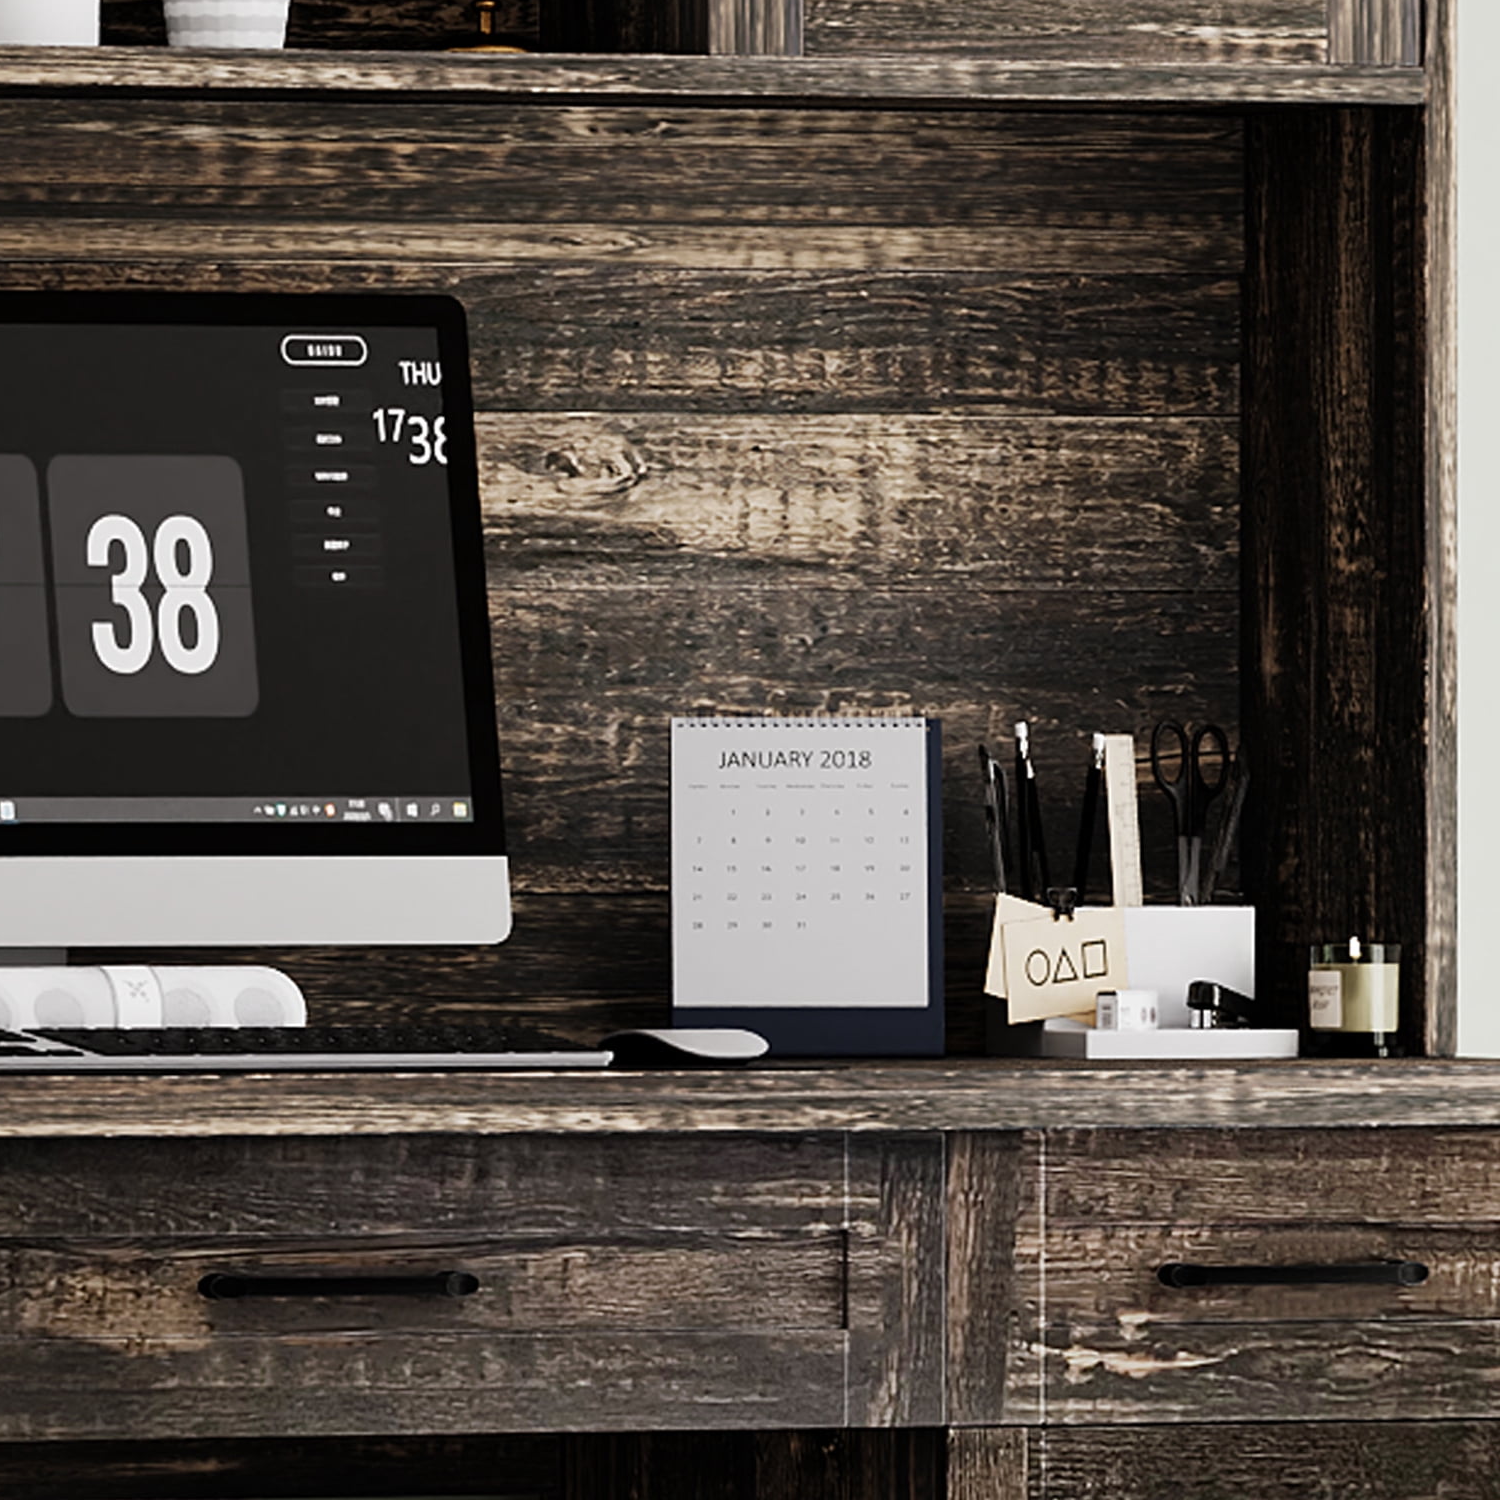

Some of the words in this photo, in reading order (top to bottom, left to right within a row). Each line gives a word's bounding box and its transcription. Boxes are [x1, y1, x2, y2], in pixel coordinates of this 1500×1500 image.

[373, 408, 406, 442] 17
[87, 515, 220, 673] 38
[719, 751, 813, 769] JANUARY
[820, 750, 872, 769] 2018
